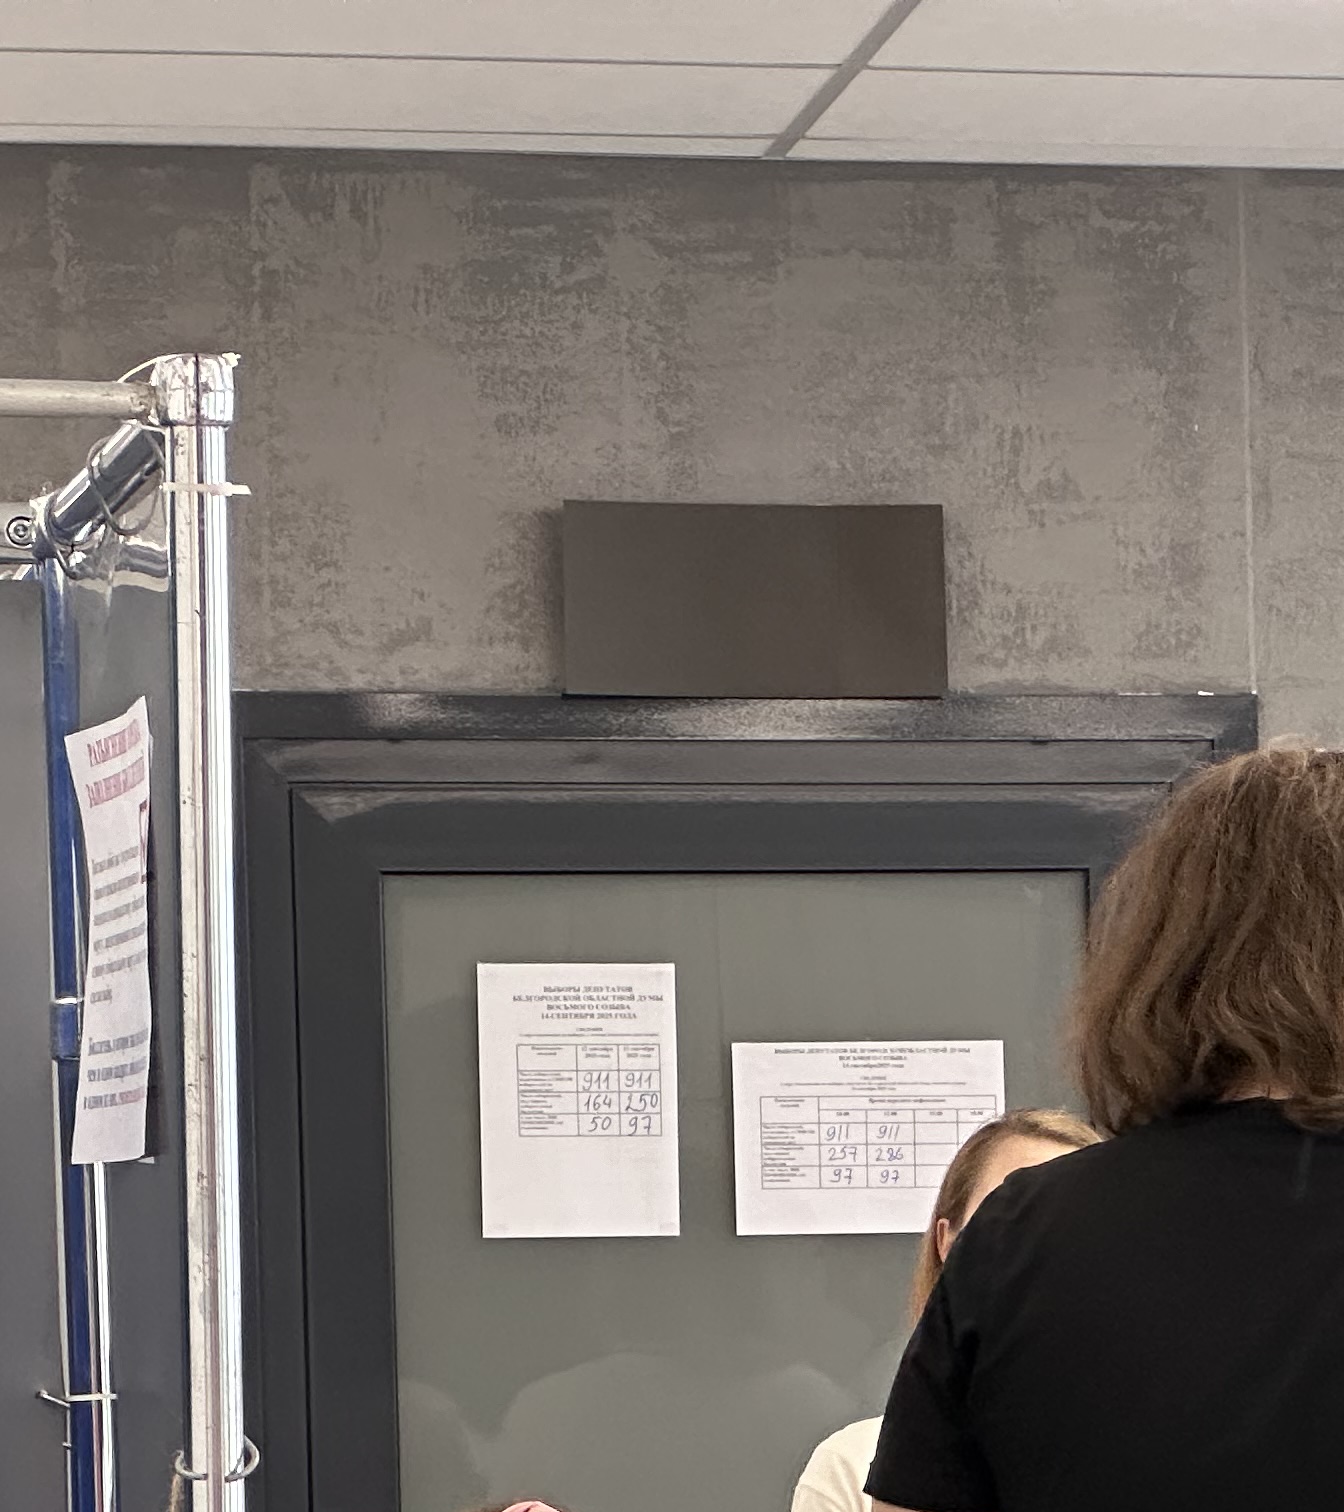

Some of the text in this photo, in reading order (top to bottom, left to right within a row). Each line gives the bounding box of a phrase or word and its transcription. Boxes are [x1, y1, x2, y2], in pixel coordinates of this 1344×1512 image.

[582, 1071, 610, 1092] 911
[624, 1072, 652, 1090] 911
[583, 1094, 612, 1112] 164
[588, 1115, 612, 1132] 50
[627, 1115, 652, 1137] 97
[876, 1124, 900, 1140] 911
[826, 1124, 850, 1142] 911
[828, 1145, 858, 1162] 257
[829, 1167, 853, 1185] 97
[880, 1169, 900, 1184] 97
